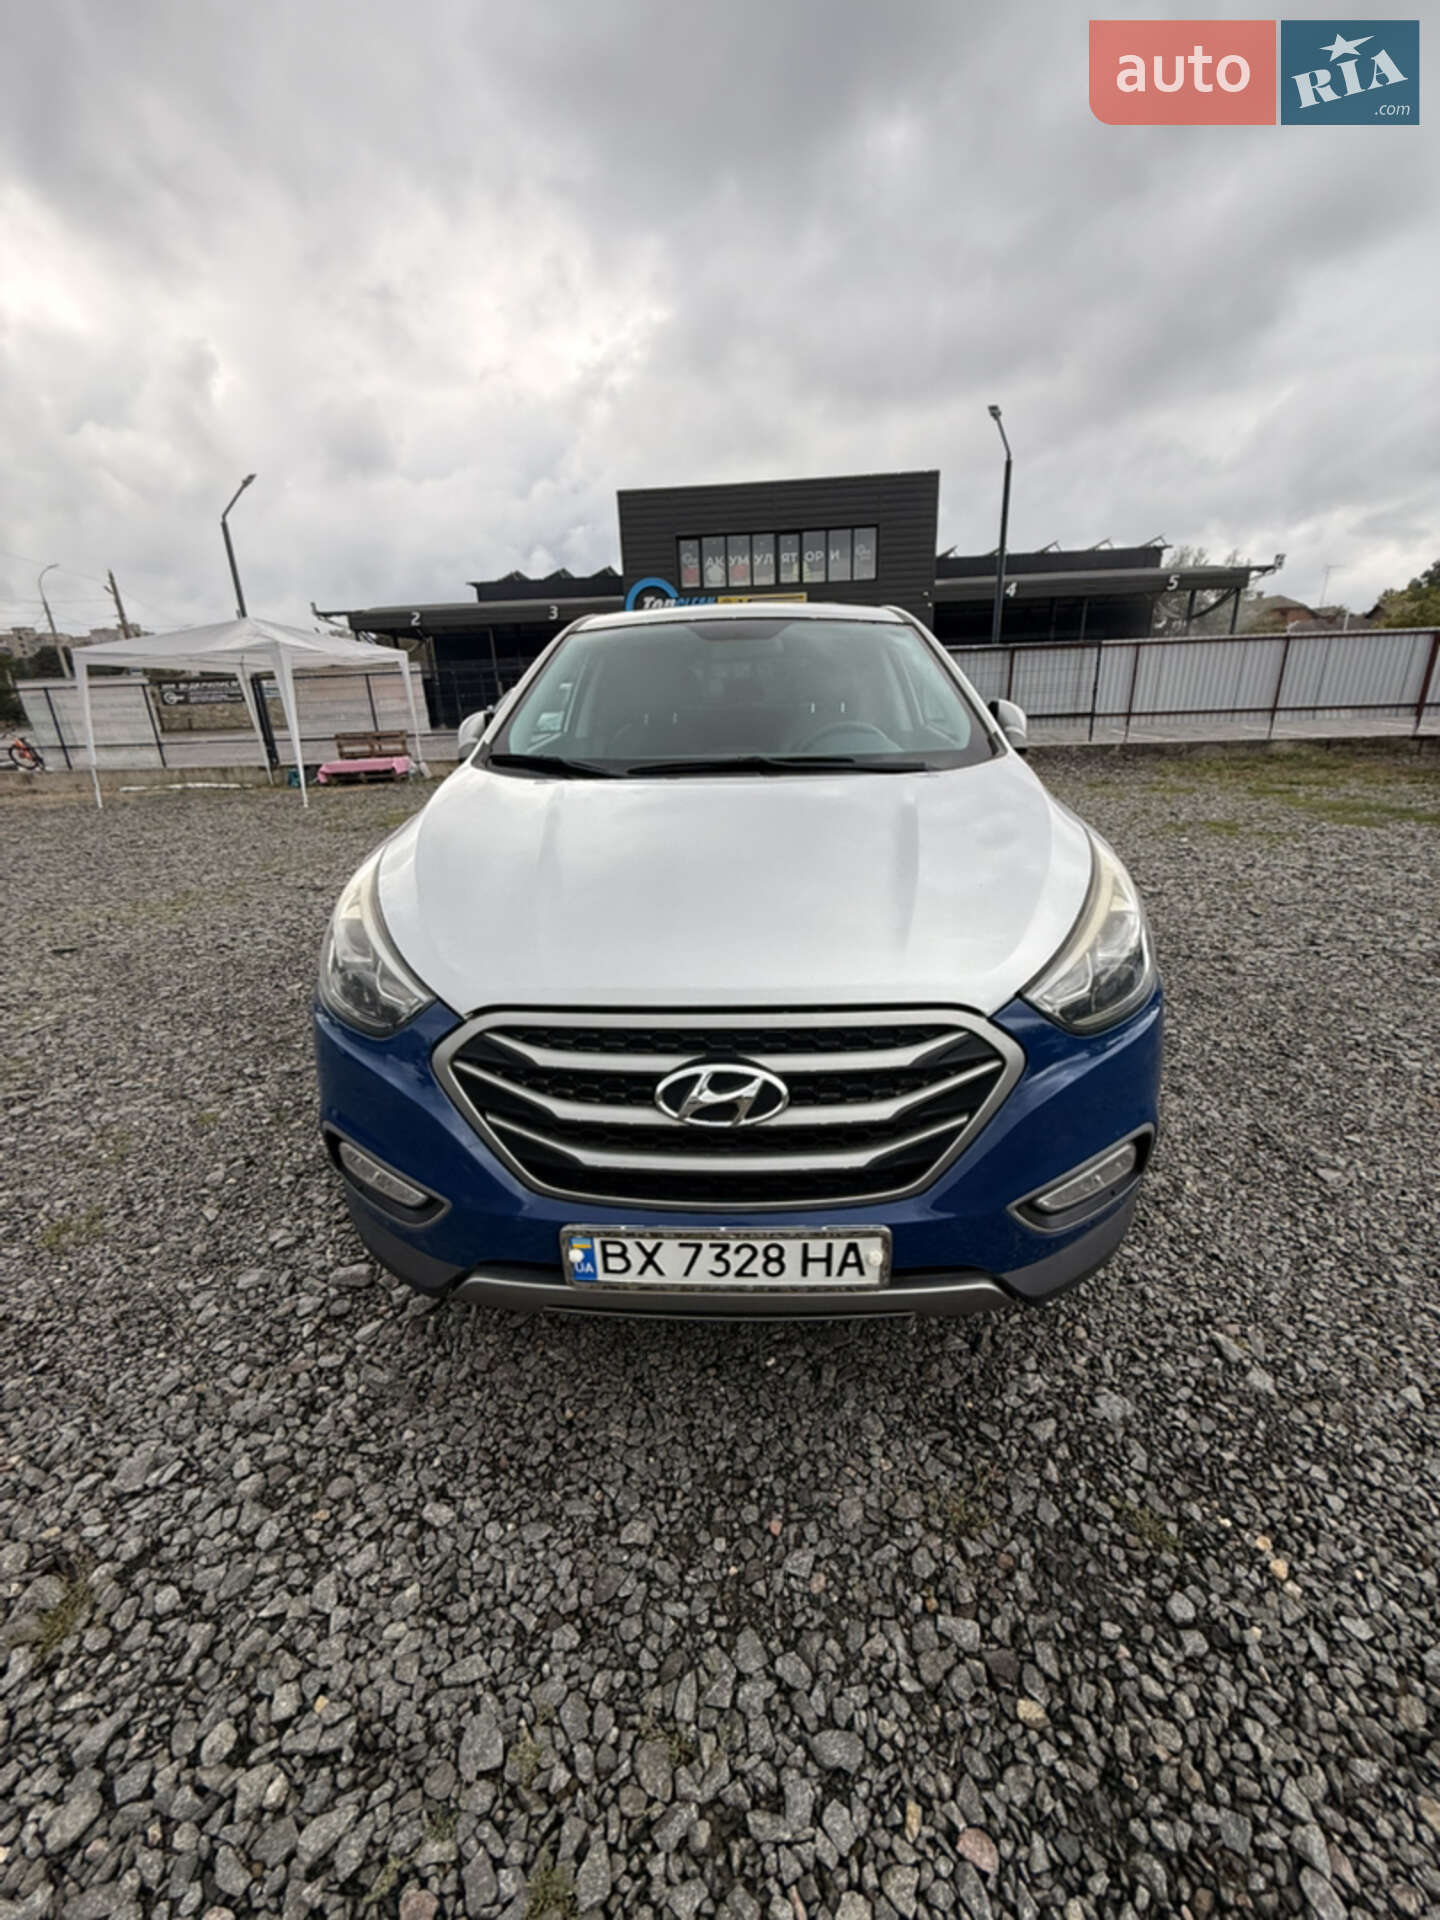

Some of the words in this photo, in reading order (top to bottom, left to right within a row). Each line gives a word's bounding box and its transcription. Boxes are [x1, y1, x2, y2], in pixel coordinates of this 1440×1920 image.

[1005, 582, 1016, 597] 4
[1168, 575, 1179, 590] 5
[411, 612, 421, 627] 2
[548, 606, 558, 620] 3
[600, 1240, 665, 1276] BX
[678, 1242, 786, 1277] 7328
[801, 1242, 866, 1277] HA
[574, 1262, 594, 1274] UA
